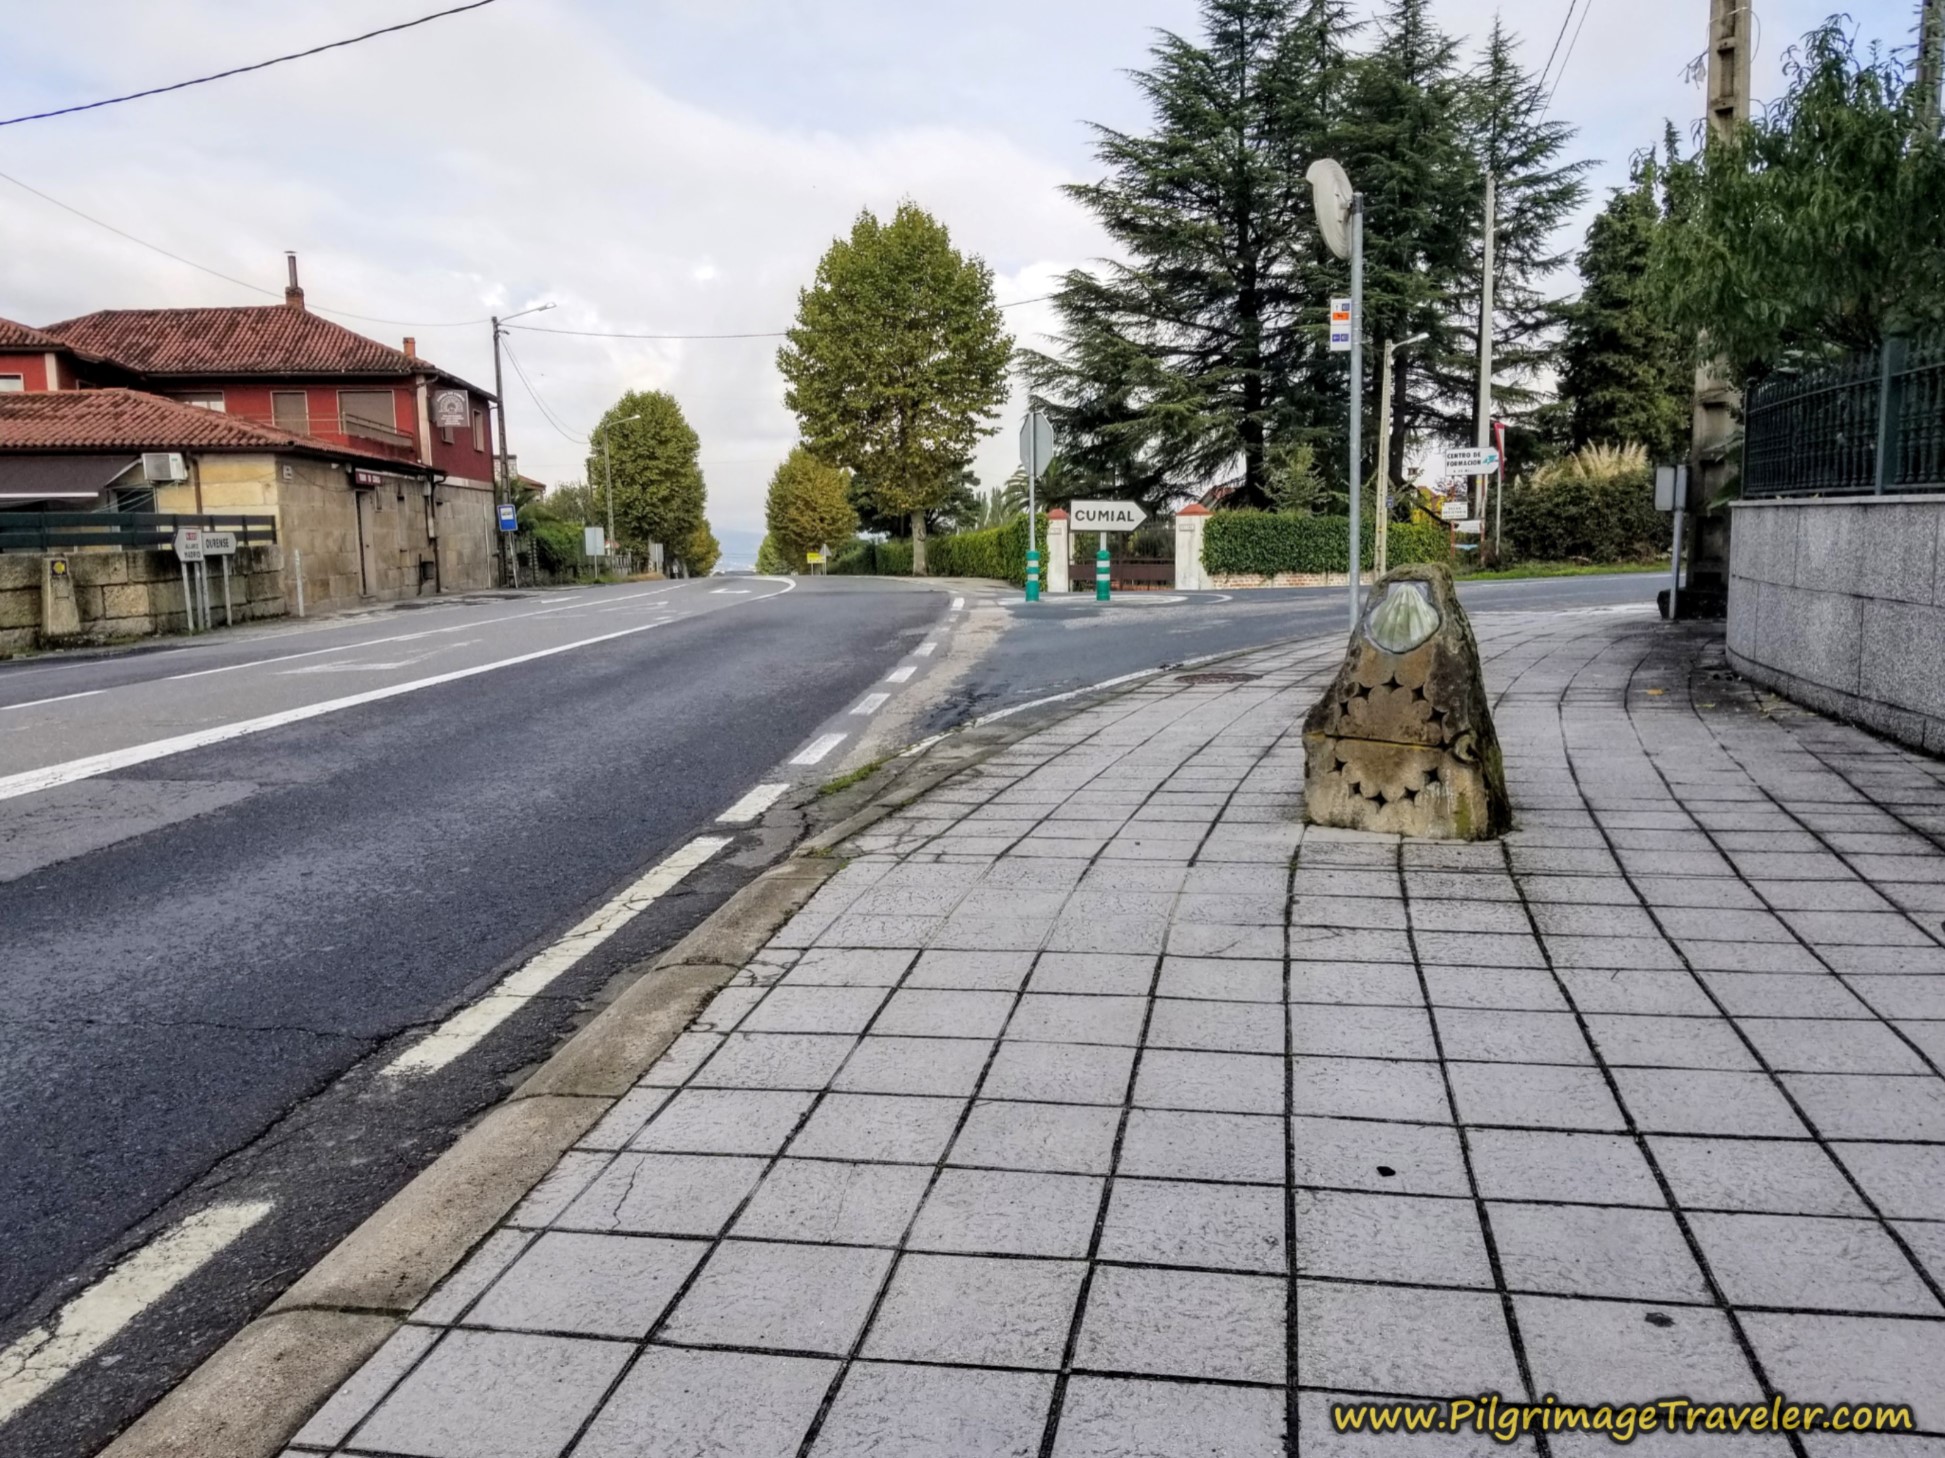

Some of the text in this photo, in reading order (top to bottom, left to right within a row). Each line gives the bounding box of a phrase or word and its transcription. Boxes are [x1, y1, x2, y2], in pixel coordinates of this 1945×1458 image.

[1075, 510, 1135, 522] CUMIAL
[206, 538, 229, 549] OURENSE
[184, 551, 201, 559] MADRID
